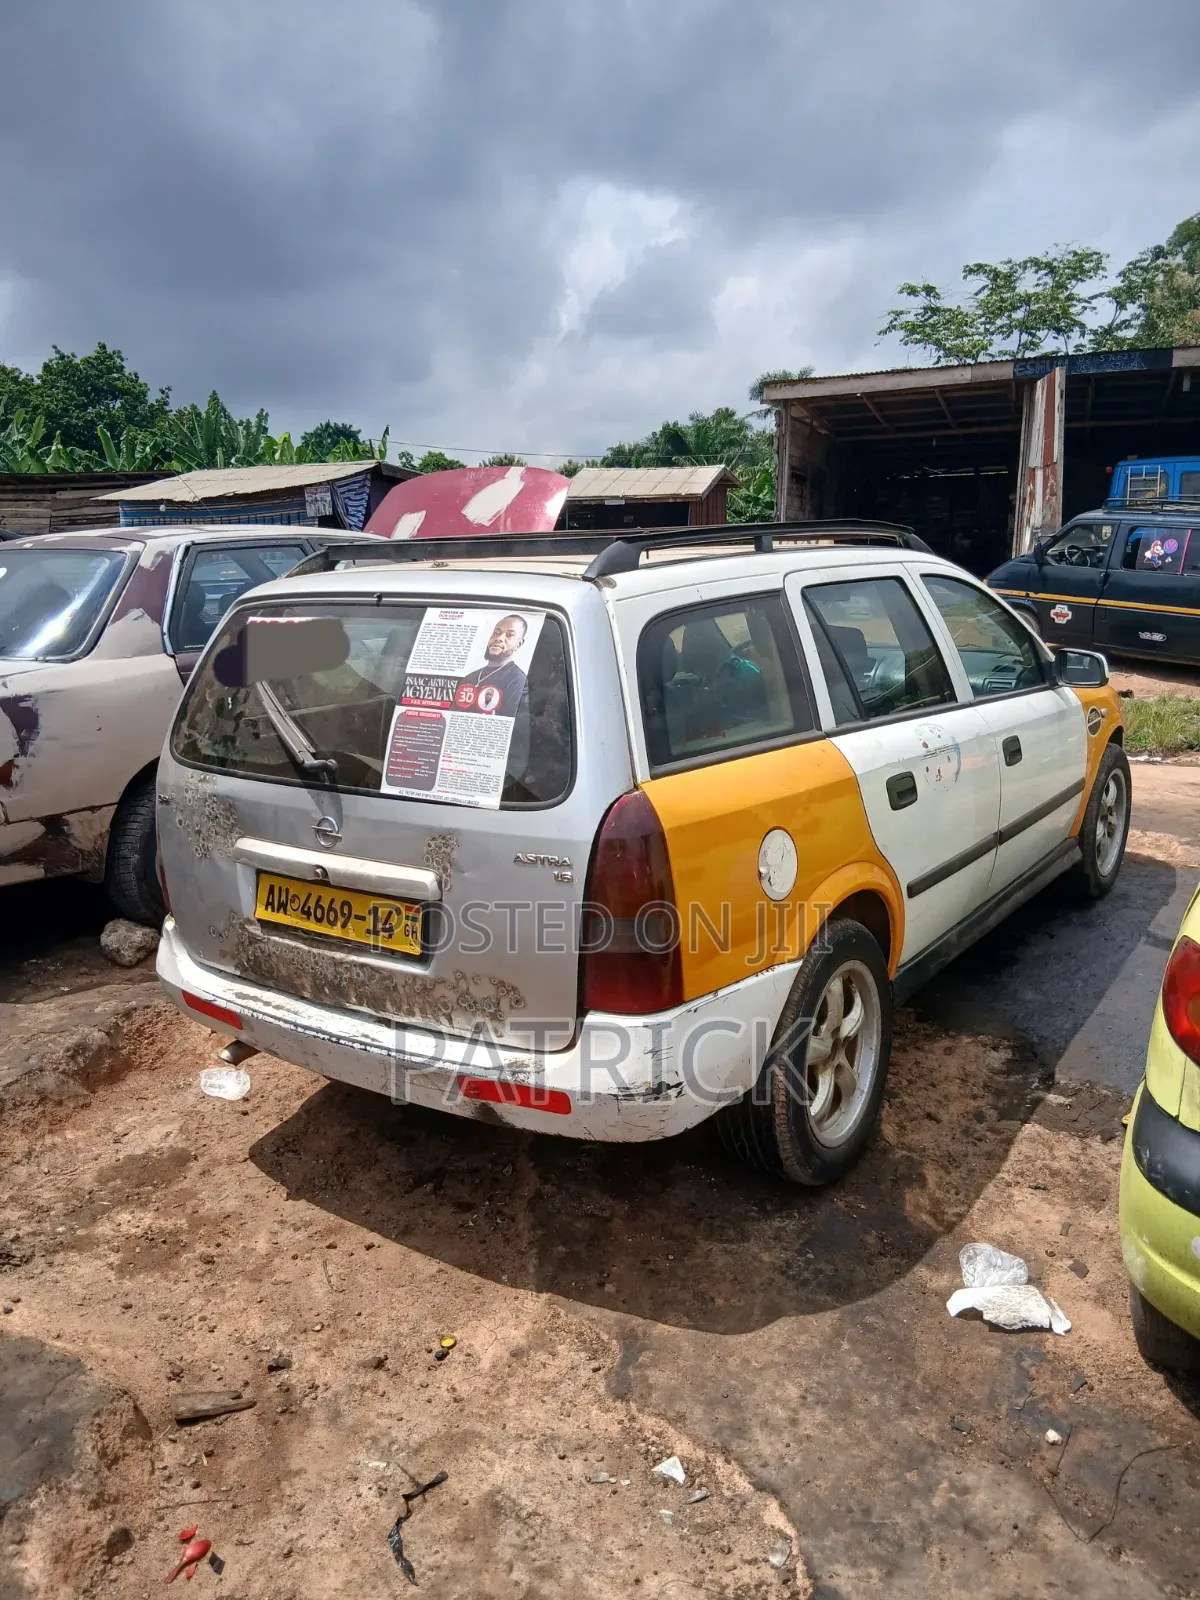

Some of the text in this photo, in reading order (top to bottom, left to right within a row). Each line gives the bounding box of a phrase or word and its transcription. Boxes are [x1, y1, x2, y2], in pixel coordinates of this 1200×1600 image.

[458, 692, 474, 703] 30
[513, 852, 574, 869] ASTRA
[404, 923, 418, 940] GH
